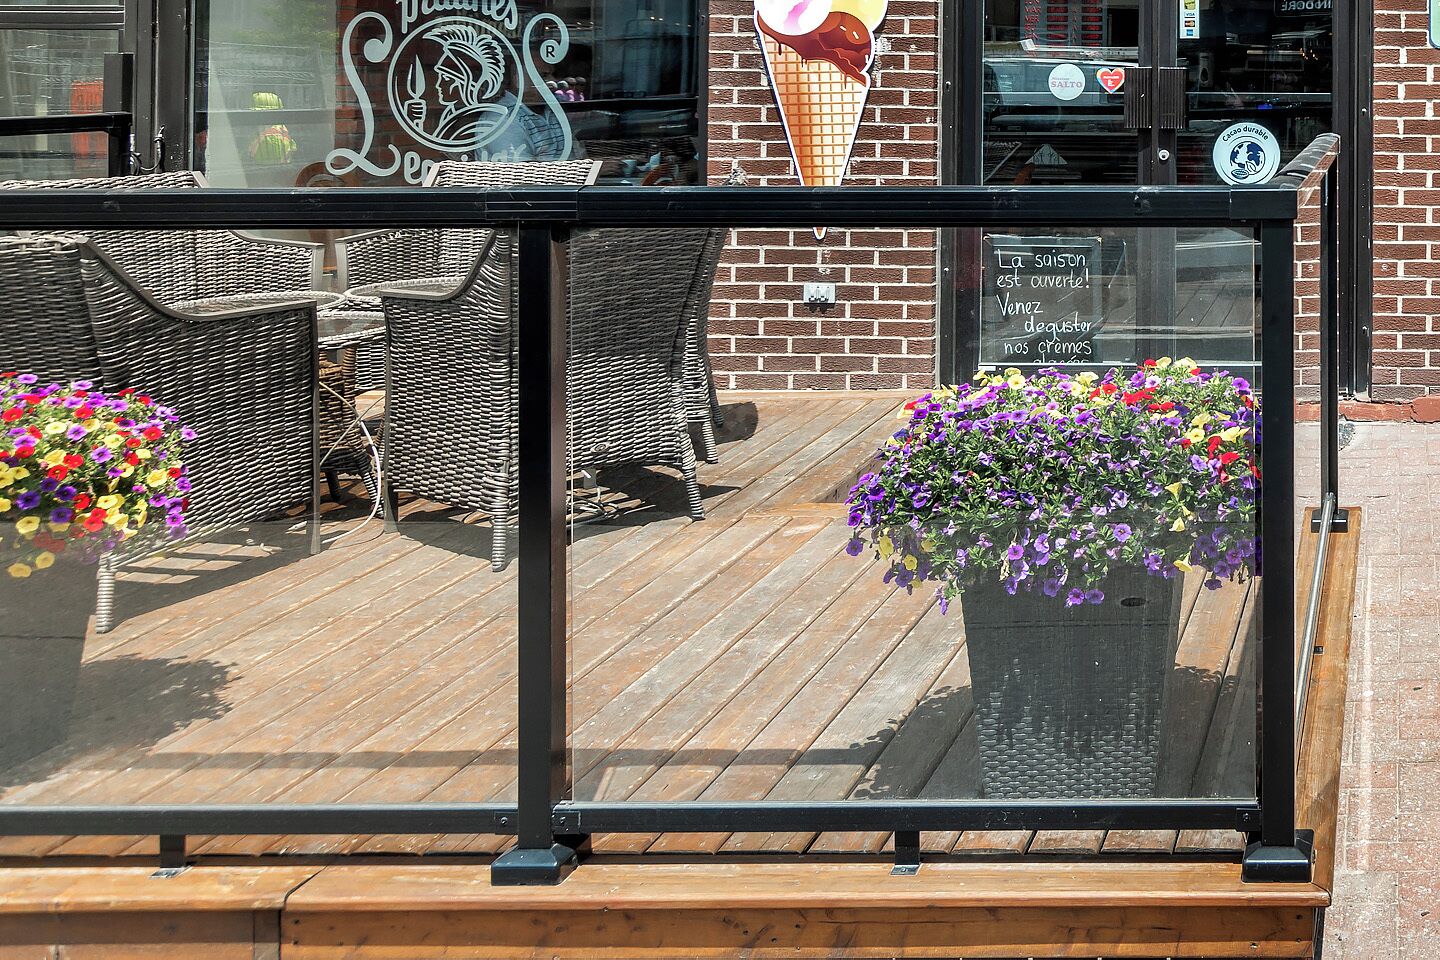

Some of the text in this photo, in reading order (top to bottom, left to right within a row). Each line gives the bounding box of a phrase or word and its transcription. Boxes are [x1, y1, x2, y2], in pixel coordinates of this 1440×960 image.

[1051, 80, 1083, 88] SALTO
[1222, 125, 1269, 142] Cacao durable
[998, 248, 1086, 268] La saison
[997, 268, 1090, 289] est ouverte!
[996, 292, 1044, 316] Venez
[1004, 335, 1092, 355] nos crèmes
